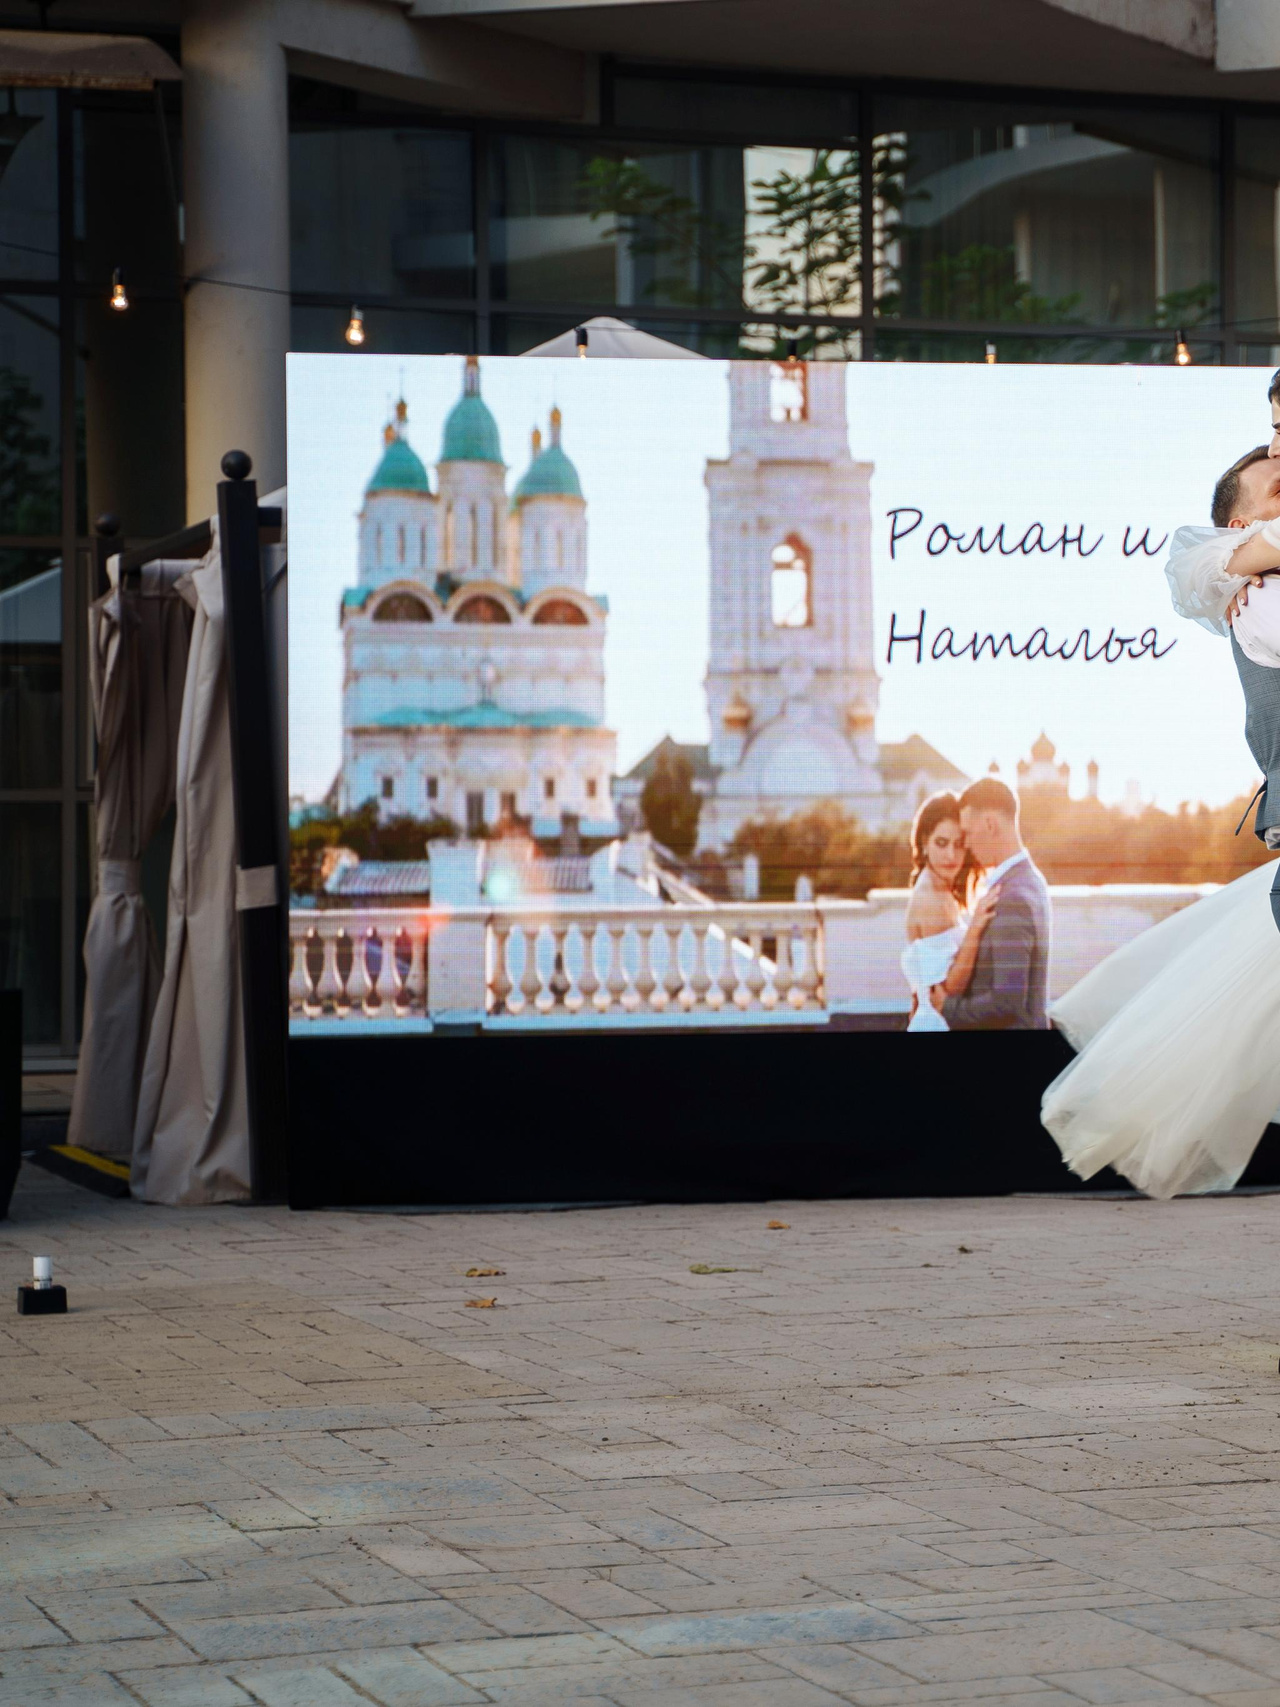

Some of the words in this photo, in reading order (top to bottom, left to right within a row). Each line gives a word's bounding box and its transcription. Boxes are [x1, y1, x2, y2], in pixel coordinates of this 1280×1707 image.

[886, 507, 1104, 560] Роман
[1122, 525, 1168, 557] и
[886, 608, 1177, 664] Наталья
